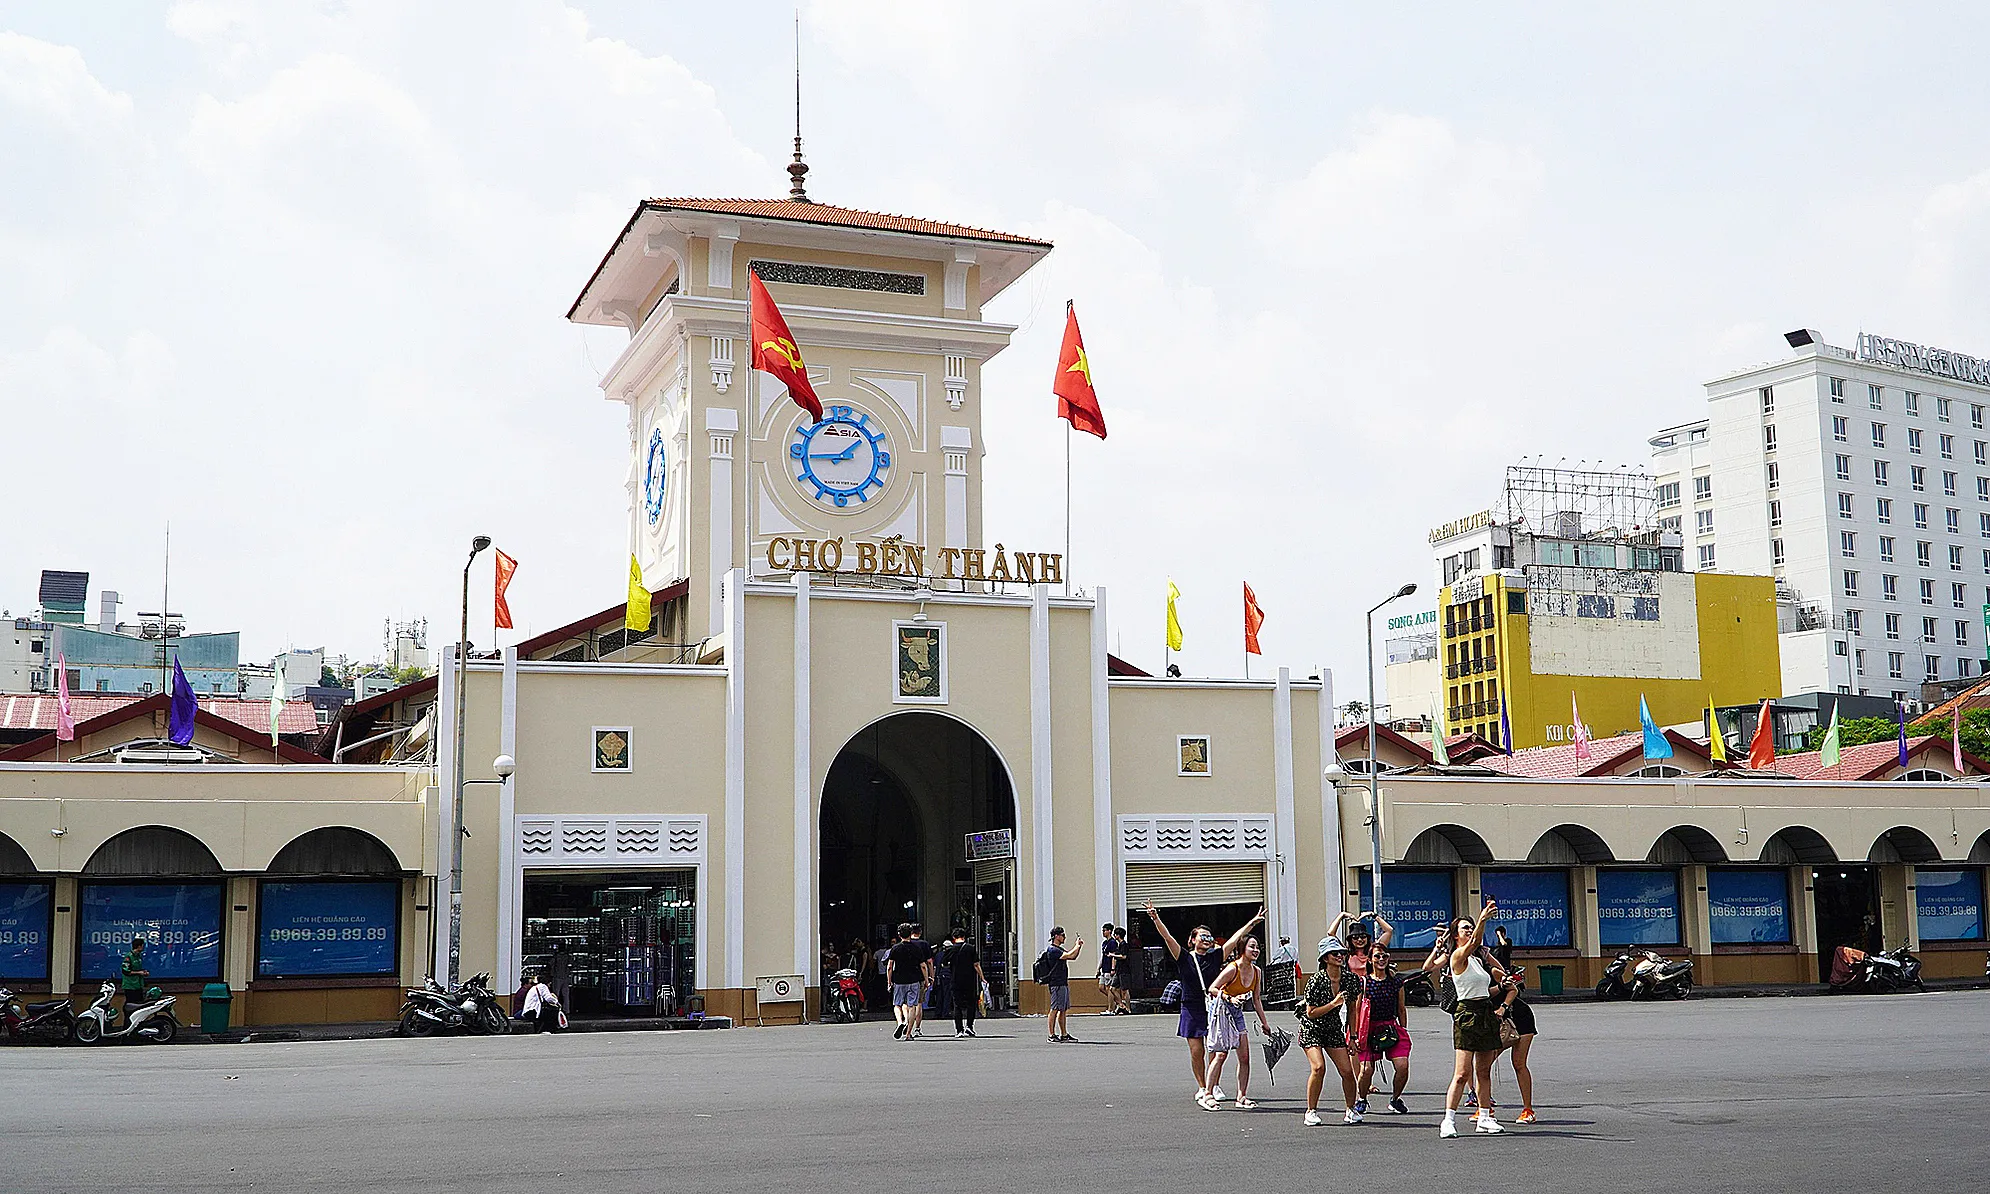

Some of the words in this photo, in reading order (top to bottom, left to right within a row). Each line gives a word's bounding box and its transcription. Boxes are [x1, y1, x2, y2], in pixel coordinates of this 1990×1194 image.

[1858, 332, 1927, 369] LIBERTY
[831, 405, 853, 422] 12
[824, 424, 861, 438] ASIA
[790, 443, 806, 459] 9
[878, 451, 891, 468] 3
[834, 492, 848, 507] 6
[767, 536, 844, 577] CHỢ
[855, 534, 926, 577] BẾN
[937, 543, 1063, 583] THÀNH
[1545, 724, 1564, 741] KOI
[1566, 723, 1593, 741] CA
[1599, 907, 1673, 918] 0969.39.89.89
[1711, 906, 1783, 917] 0969.39.89.89
[270, 928, 387, 941] 0969.39.89.89
